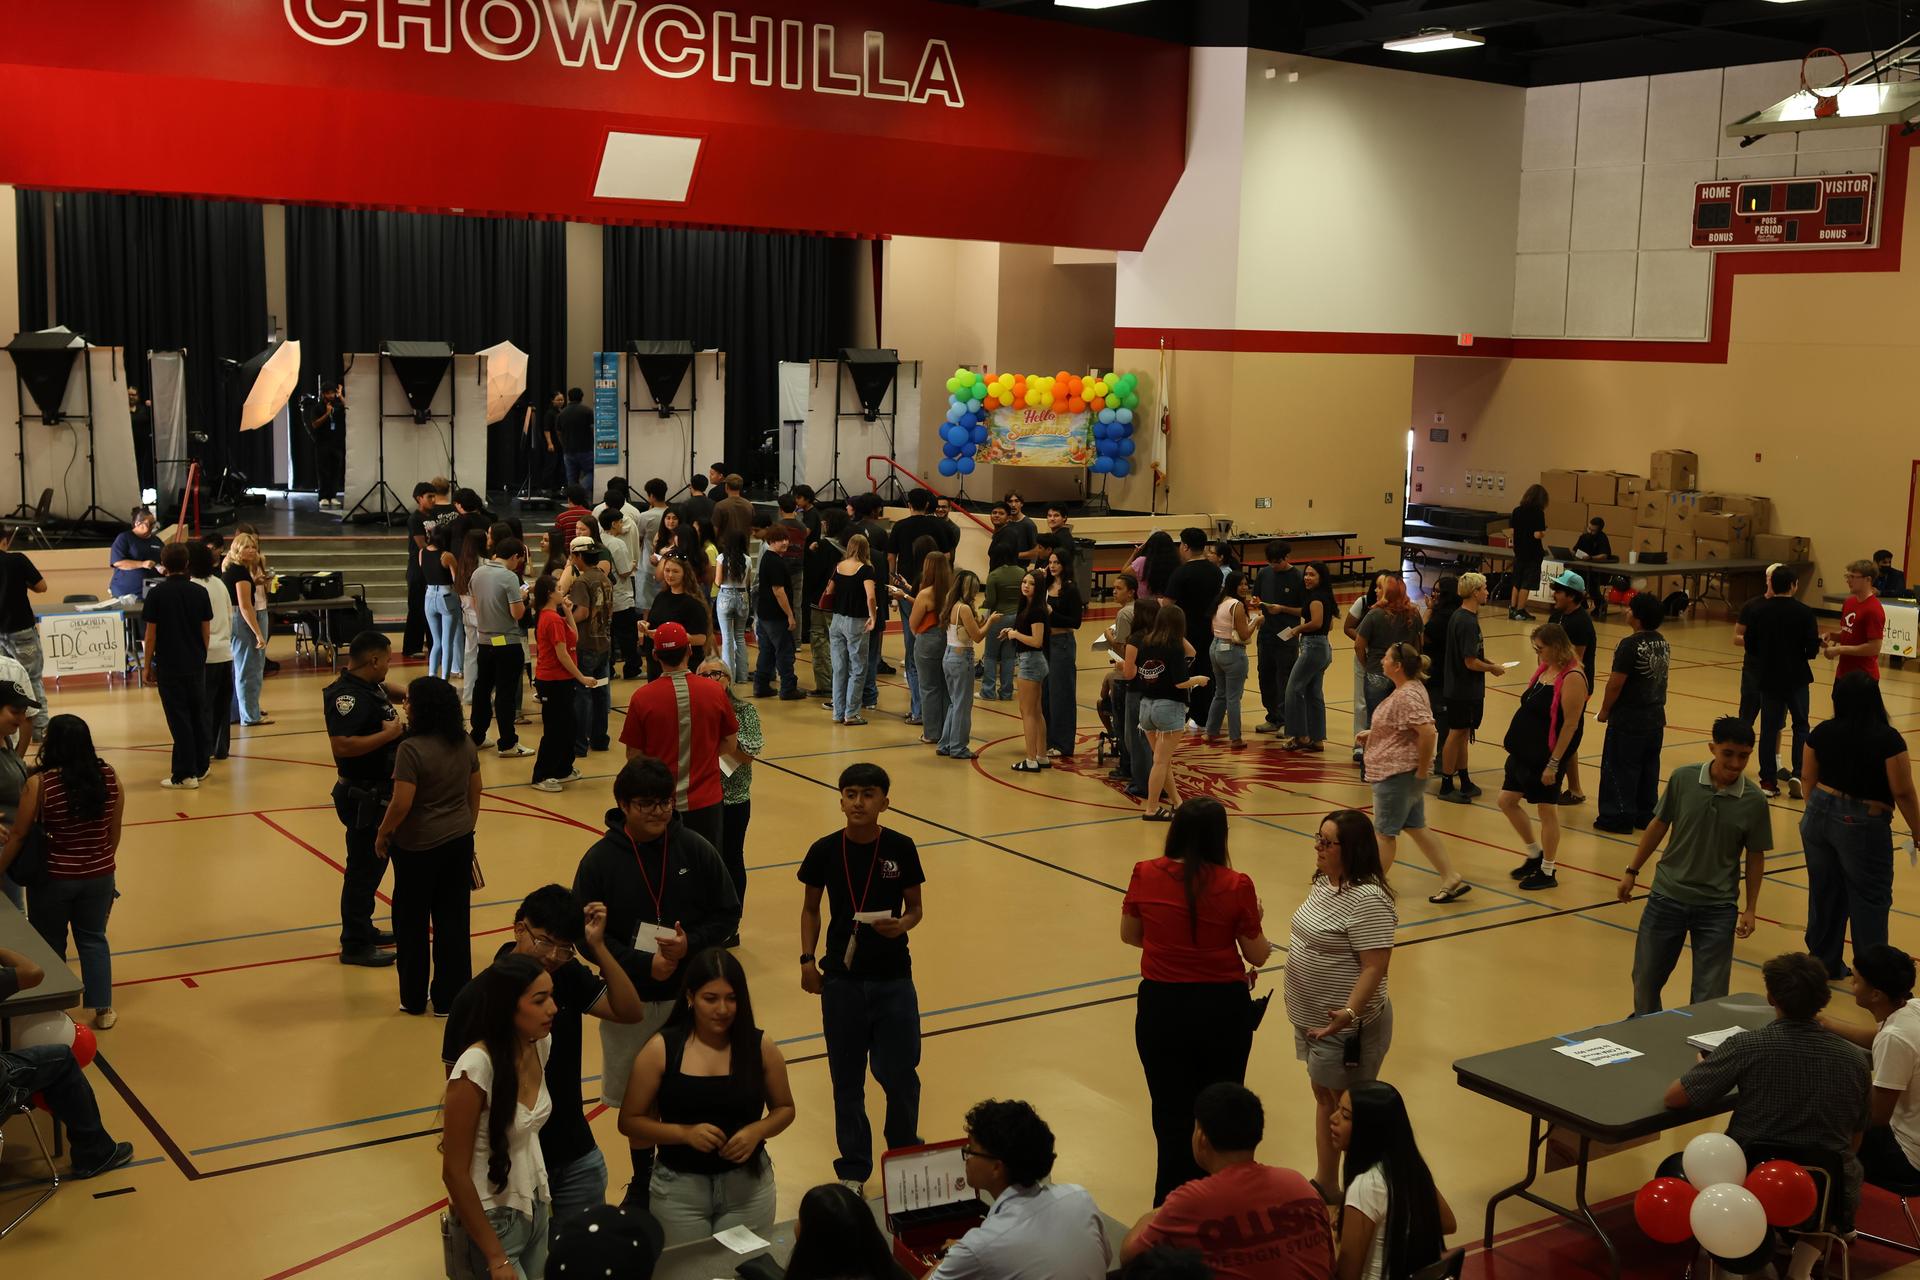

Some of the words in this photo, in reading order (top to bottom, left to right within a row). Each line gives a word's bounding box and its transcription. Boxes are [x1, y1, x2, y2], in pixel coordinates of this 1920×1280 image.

[284, 0, 965, 108] CHOWCHILLA
[1702, 186, 1731, 199] HOME
[1825, 179, 1869, 194] VISITOR
[1761, 217, 1777, 225] POSS
[1754, 225, 1783, 235] PERIOD
[1819, 229, 1847, 239] BONUS
[1708, 233, 1734, 242] BONUS
[1024, 408, 1056, 424] Hello
[47, 633, 74, 658] ID
[75, 629, 118, 656] Cards
